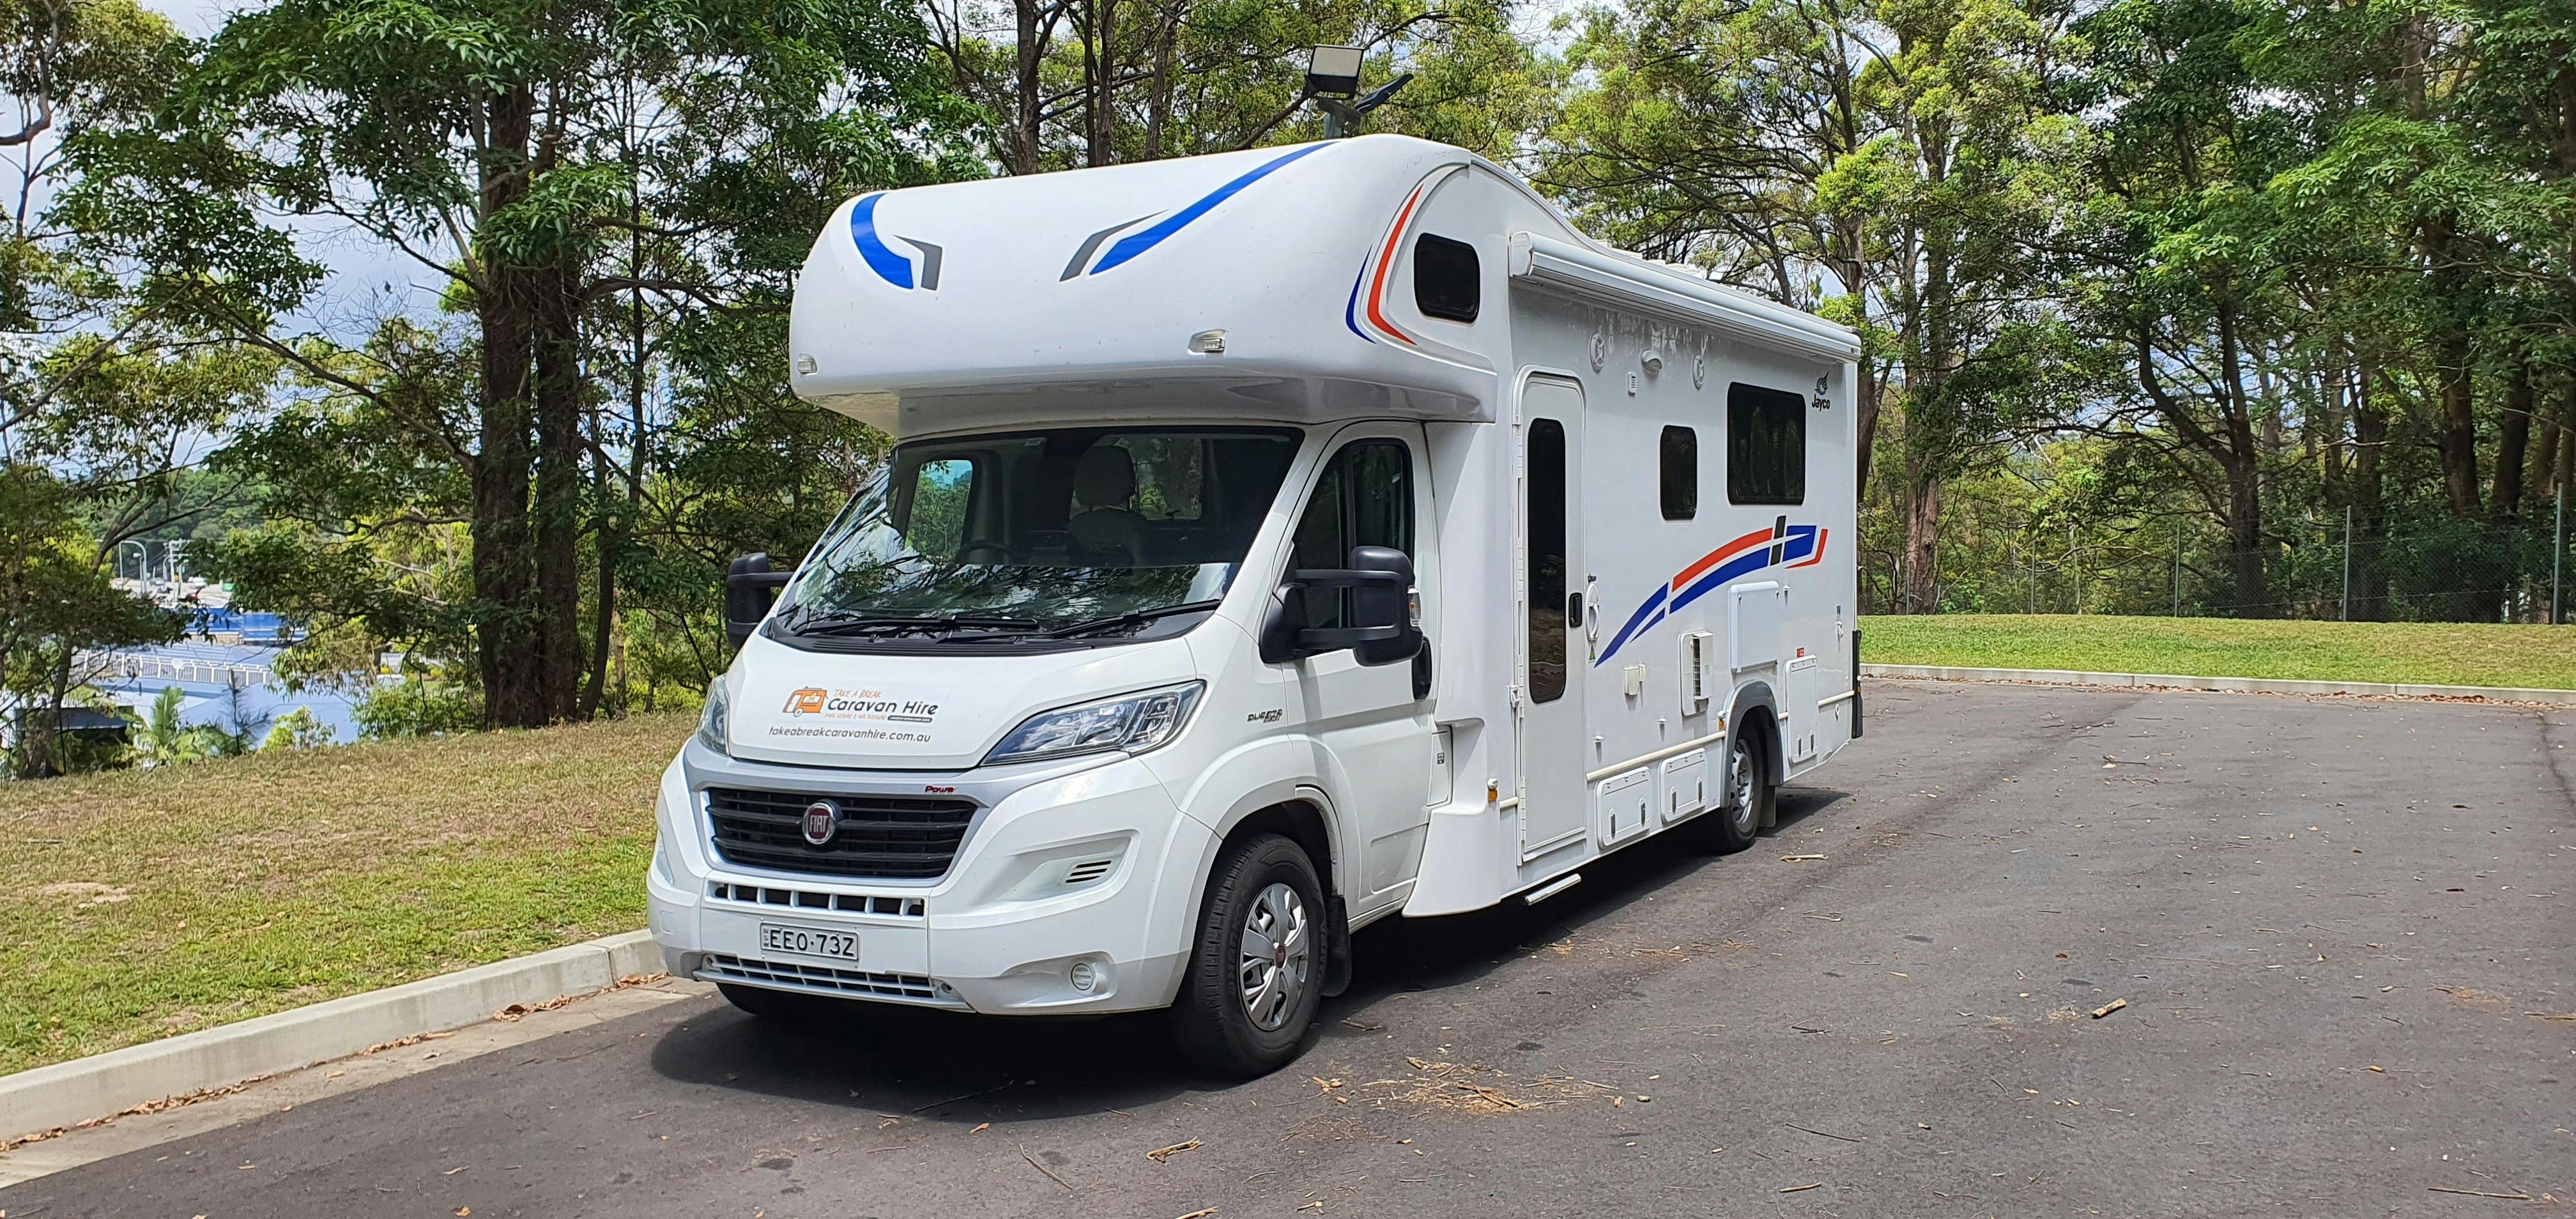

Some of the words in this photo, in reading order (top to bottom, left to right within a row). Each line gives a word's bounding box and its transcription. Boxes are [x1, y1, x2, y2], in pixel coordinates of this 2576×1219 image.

[1812, 394, 1830, 412] Jayco
[833, 689, 852, 698] TAKE
[858, 689, 883, 698] BREAK
[827, 698, 897, 713] Caravan
[902, 701, 939, 715] Hire
[769, 726, 931, 742] takeabreakcaravanhire.com.au
[809, 815, 829, 833] FIAT
